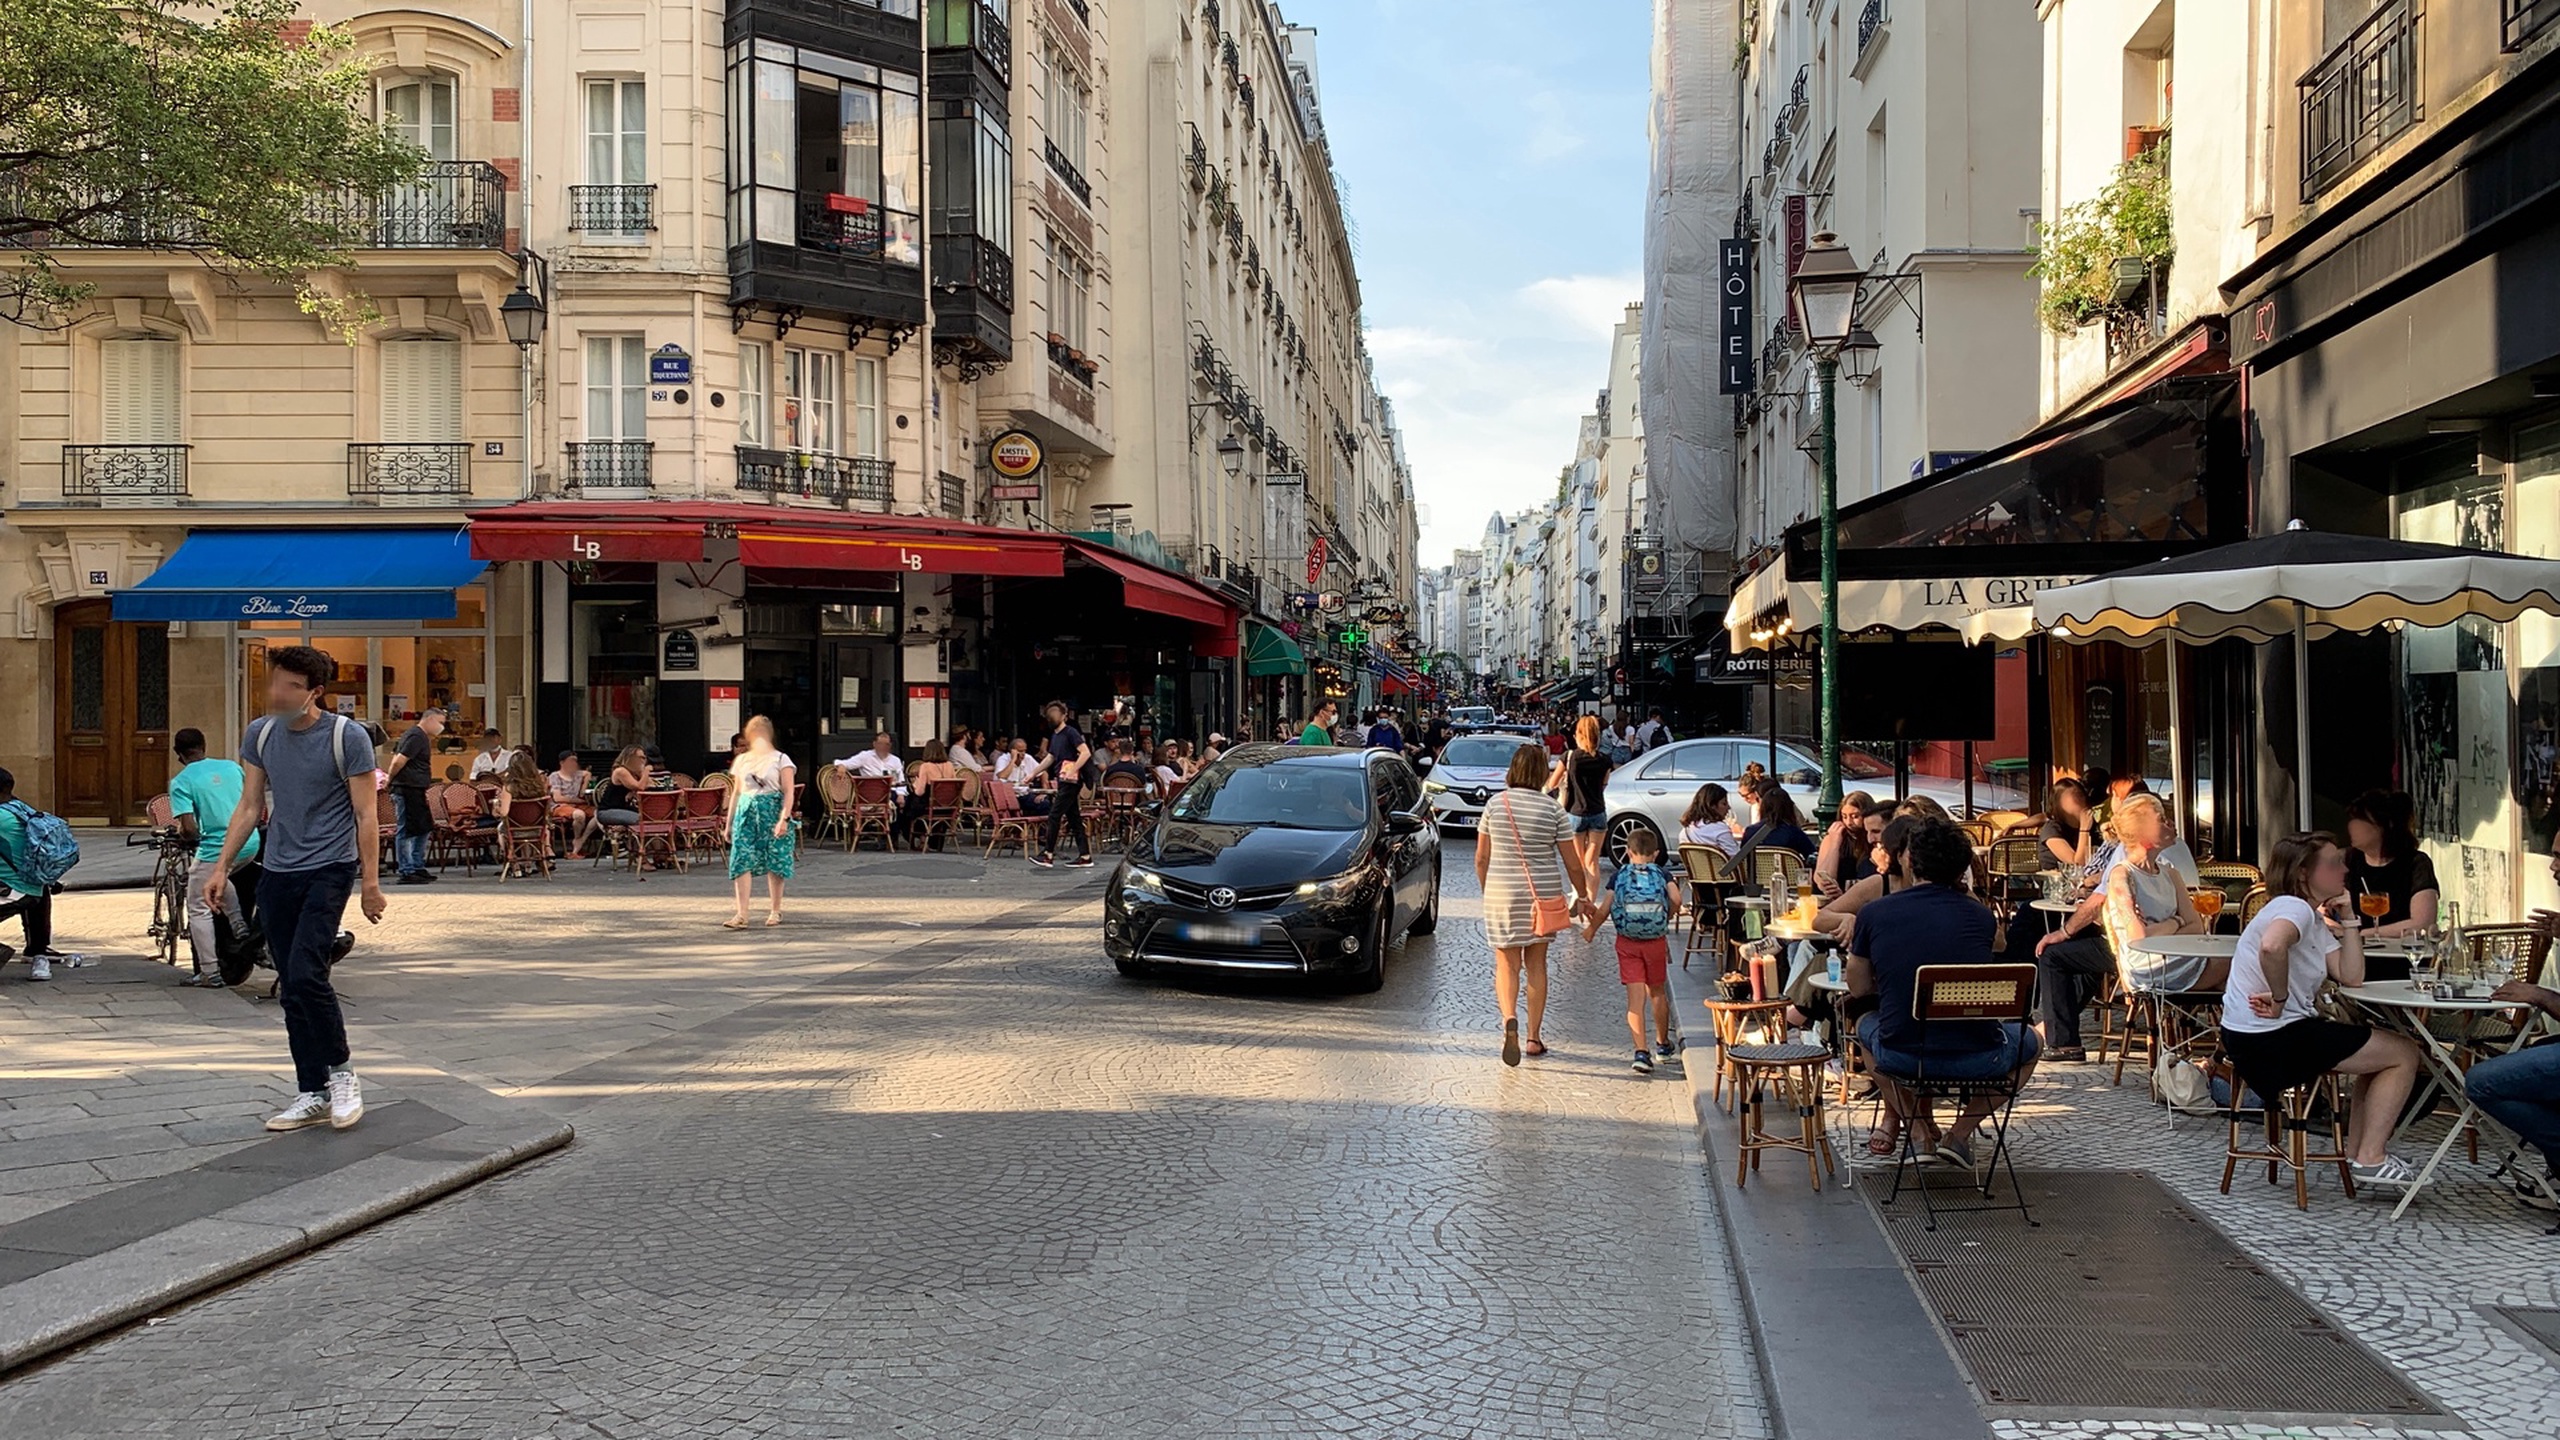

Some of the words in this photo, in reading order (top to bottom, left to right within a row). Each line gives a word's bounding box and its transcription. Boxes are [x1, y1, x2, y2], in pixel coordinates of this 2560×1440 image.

[1726, 247, 1745, 385] HÔTEL
[663, 362, 680, 370] RUE
[653, 390, 667, 401] 52
[487, 443, 501, 454] 54
[1001, 448, 1029, 456] AMSTEL
[573, 534, 601, 560] LB
[901, 547, 923, 570] LB
[1924, 580, 1969, 606] LA
[241, 595, 282, 614] Blue
[285, 595, 329, 618] Lemon
